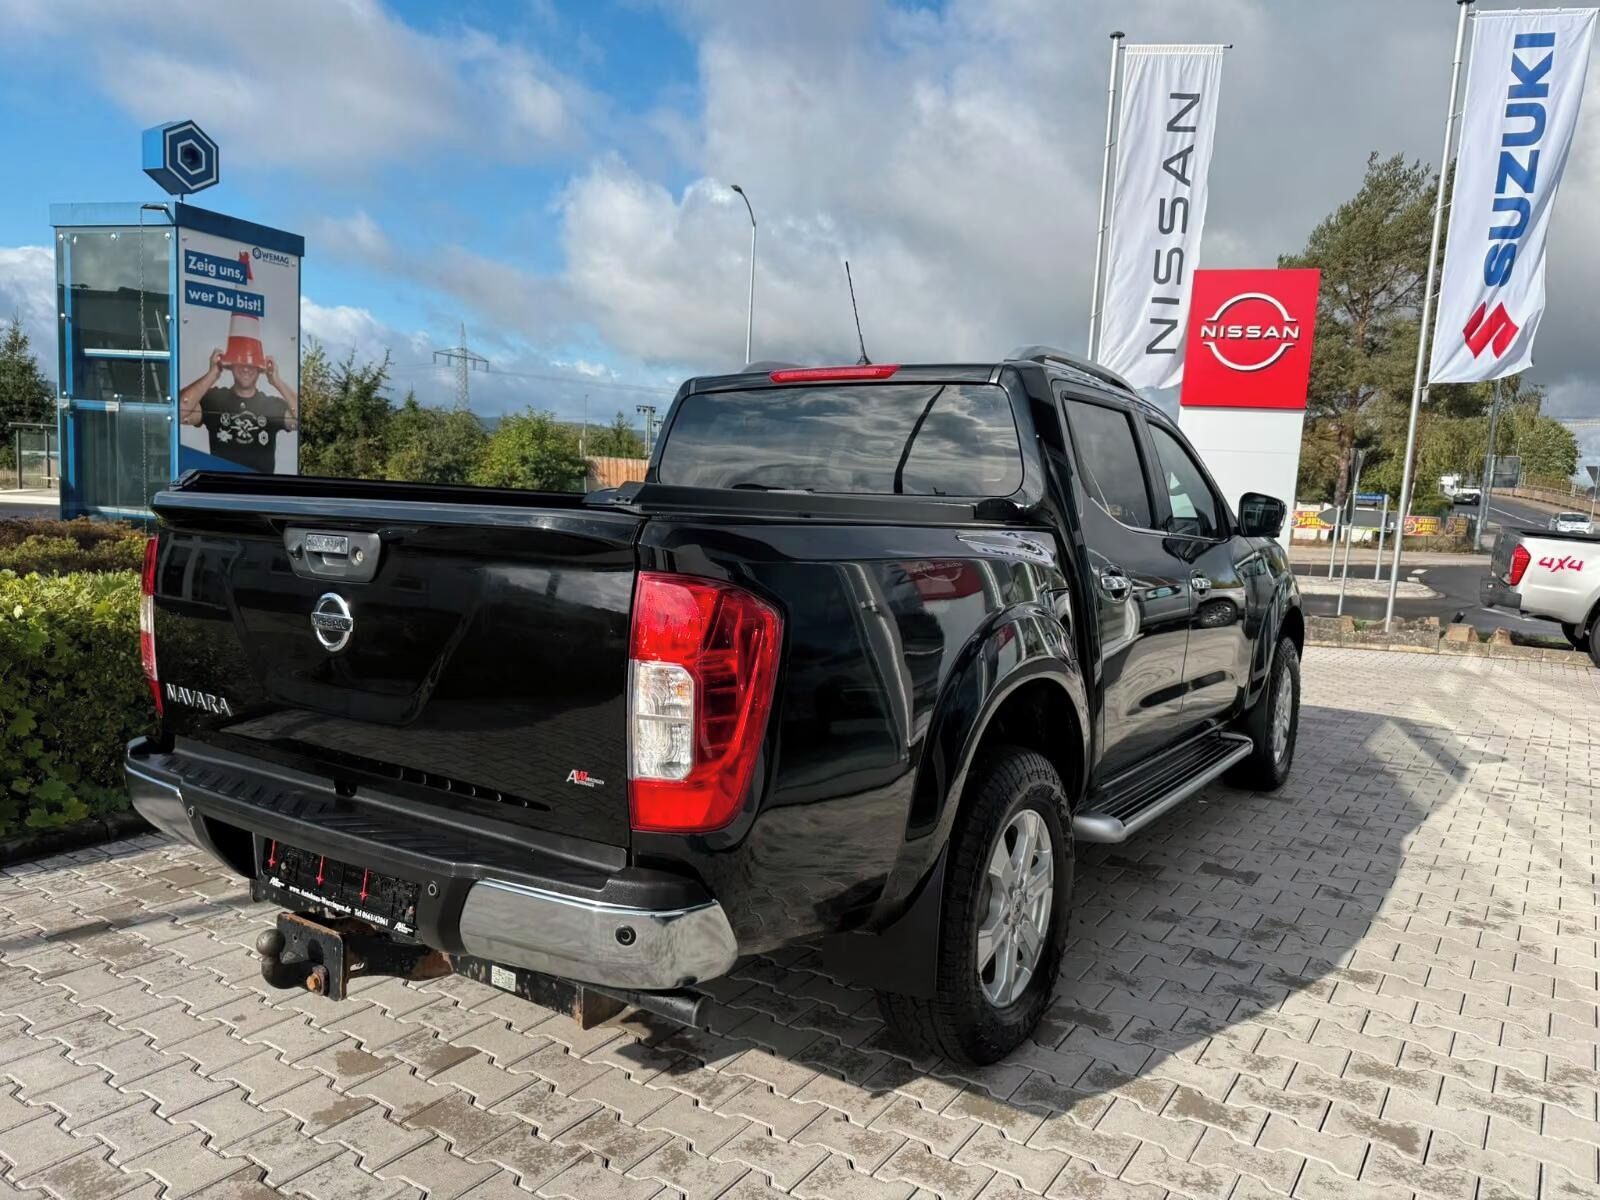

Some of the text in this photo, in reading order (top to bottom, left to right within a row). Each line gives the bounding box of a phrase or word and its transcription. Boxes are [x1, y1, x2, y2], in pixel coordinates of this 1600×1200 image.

[1484, 32, 1556, 287] SUZUKI
[1145, 93, 1200, 354] NISSAN
[188, 256, 244, 281] Zeig uns,
[261, 251, 290, 264] WEMAG
[188, 289, 262, 312] wer Du bist!
[1200, 325, 1300, 339] NISSAN
[165, 682, 233, 717] NAVARA
